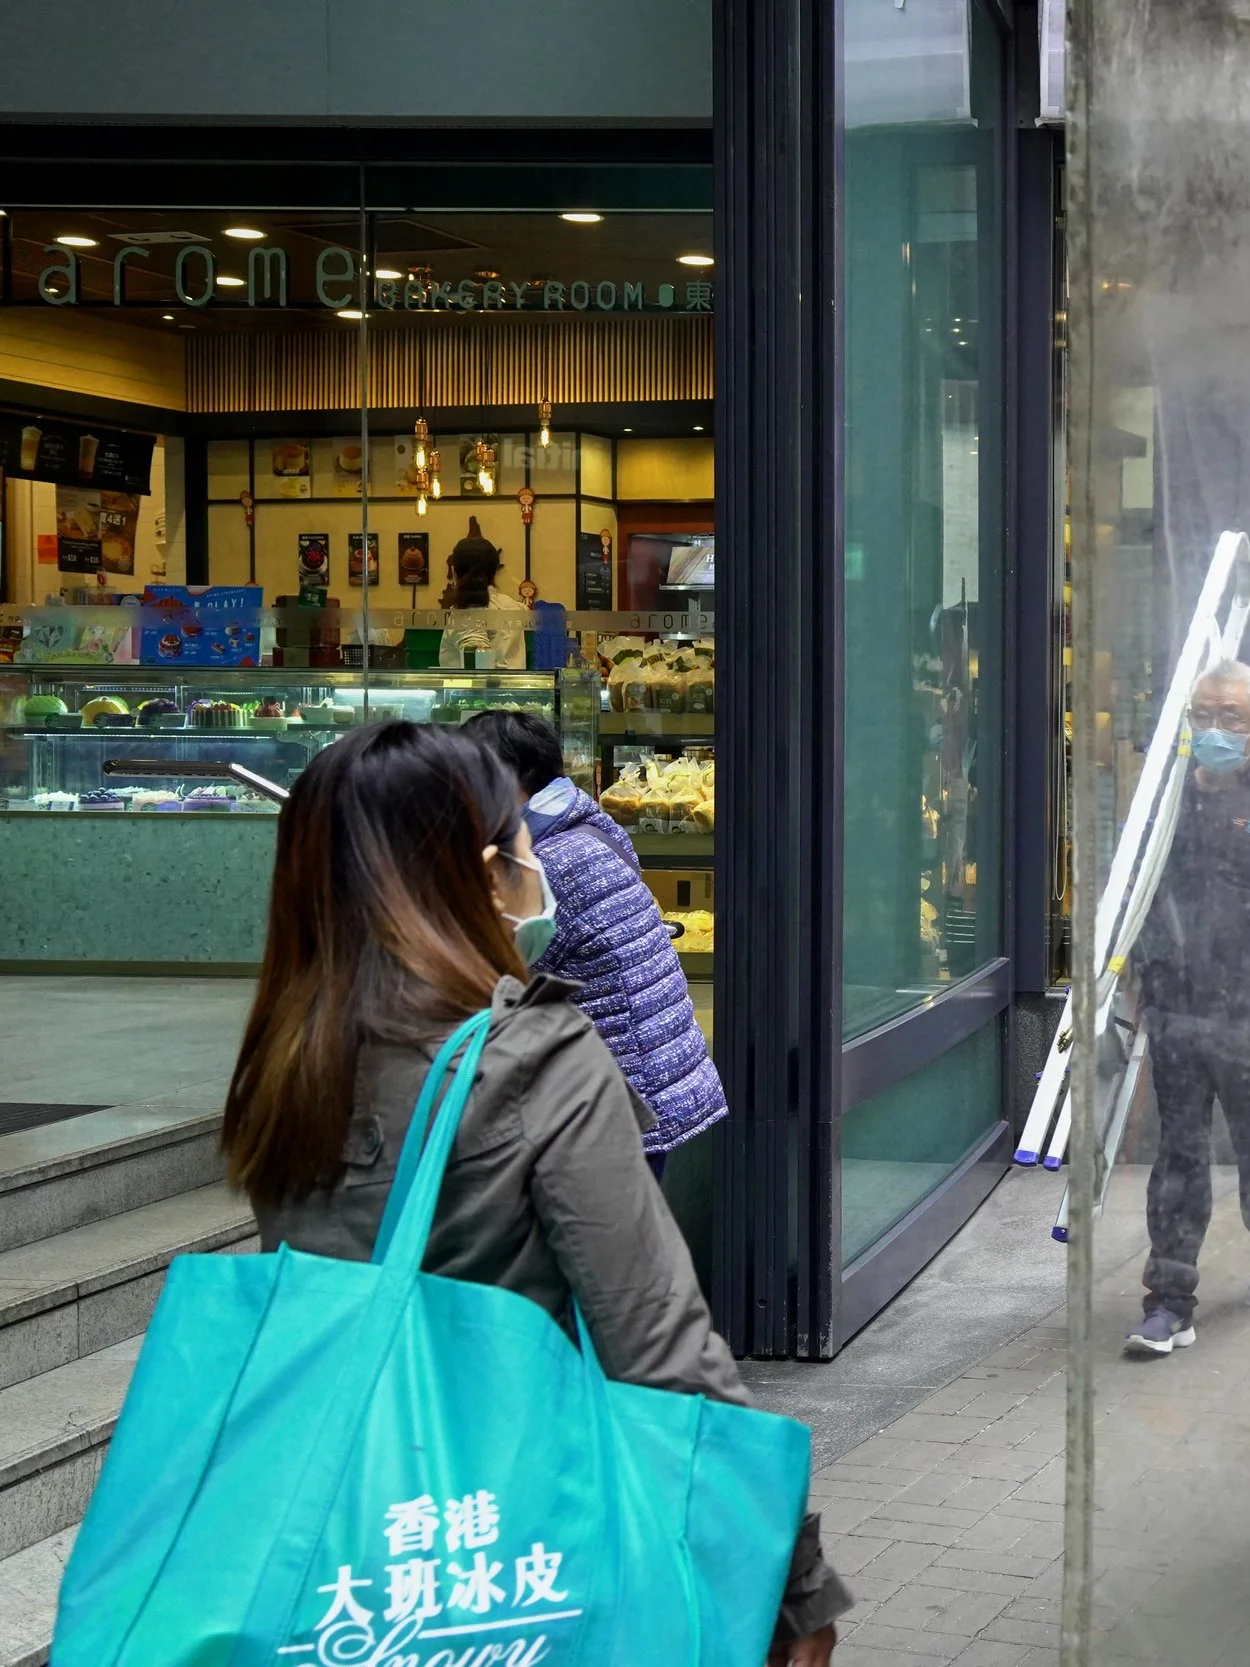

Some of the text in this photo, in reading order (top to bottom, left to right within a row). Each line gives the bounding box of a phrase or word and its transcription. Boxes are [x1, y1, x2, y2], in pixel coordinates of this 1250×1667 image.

[38, 246, 357, 308] arome
[377, 280, 643, 311] BAKERY ROOM
[384, 1489, 500, 1557] 香港
[313, 1541, 568, 1630] 大班冰皮
